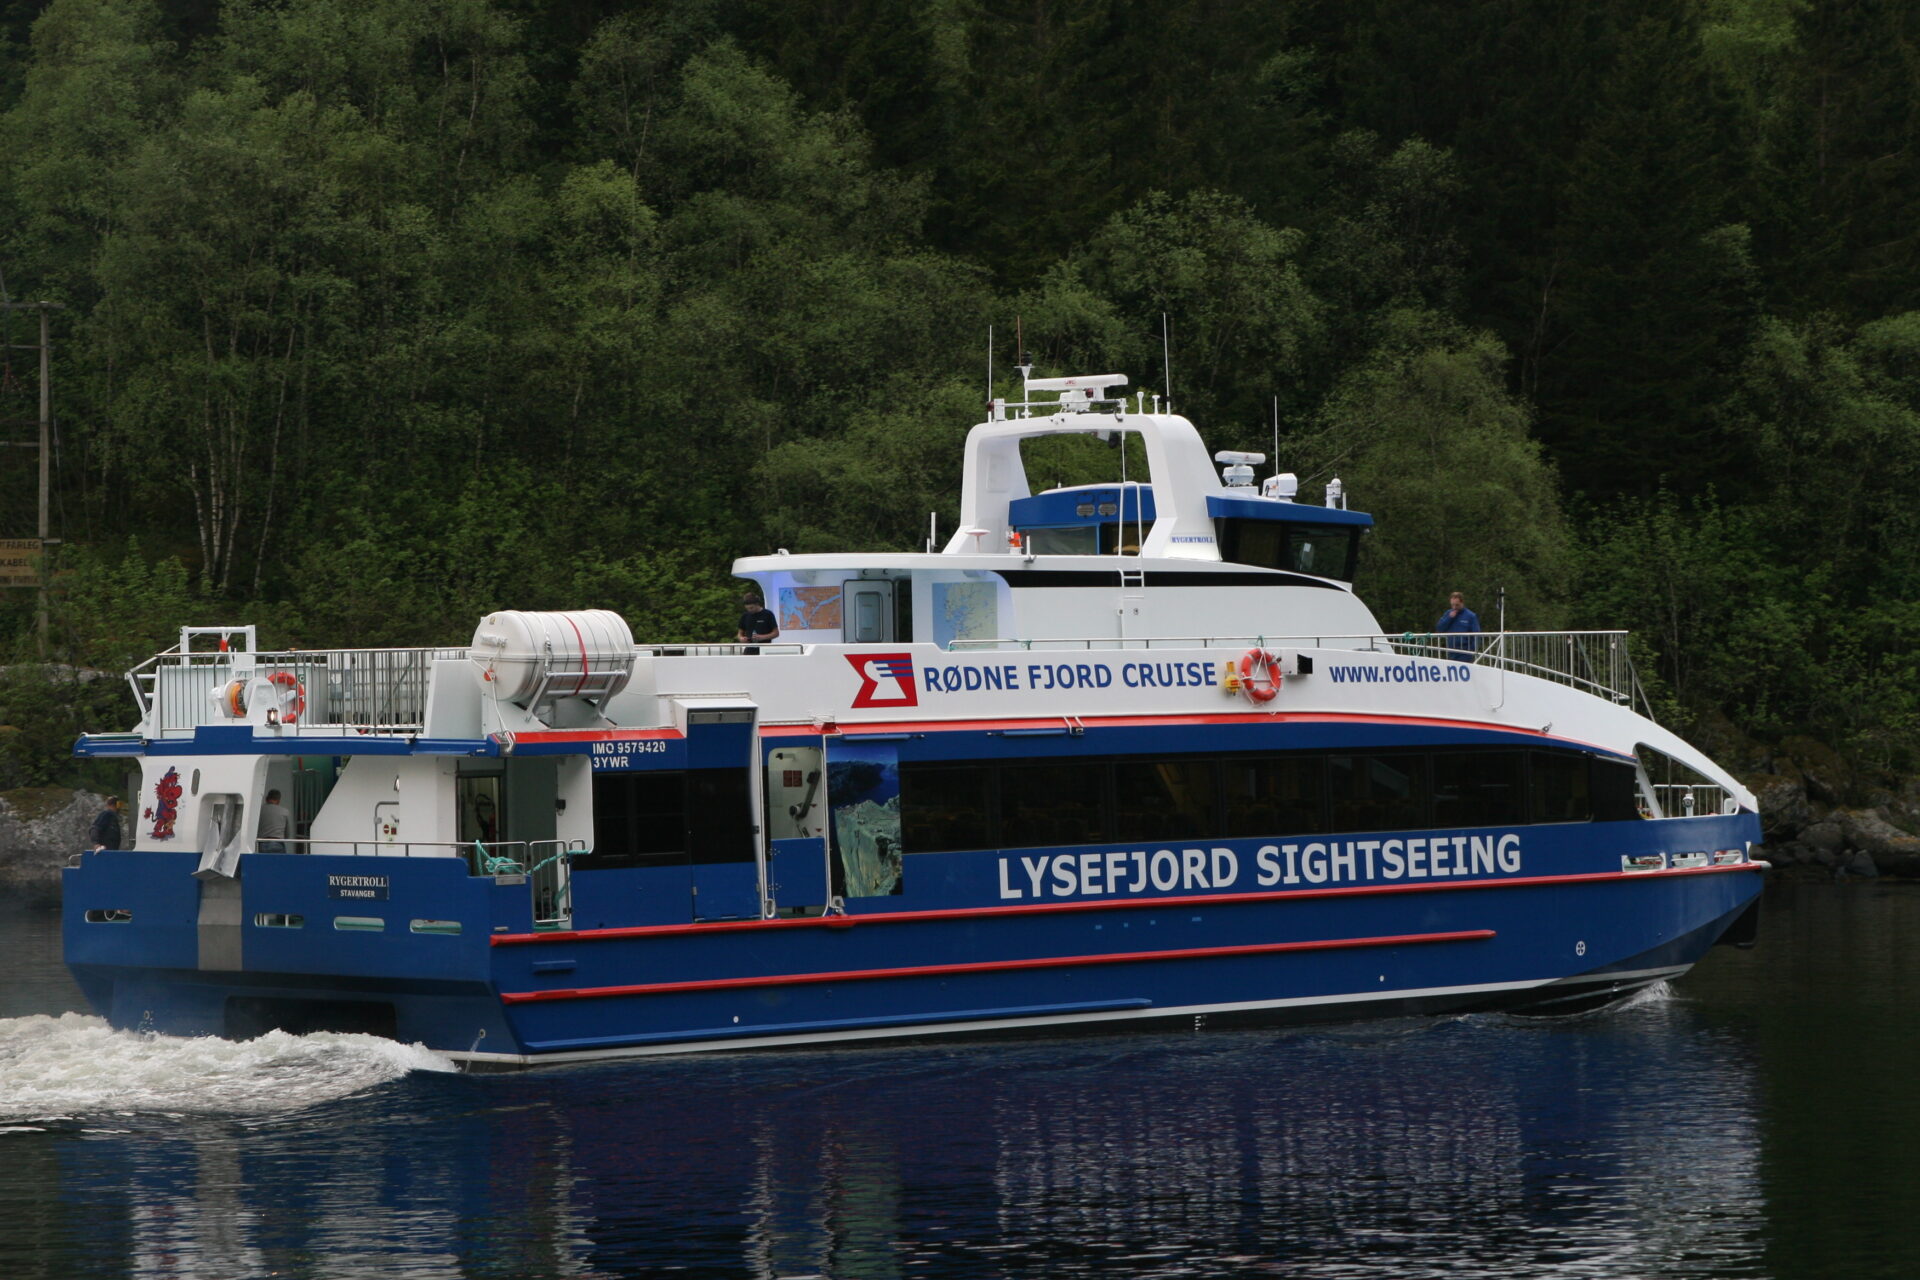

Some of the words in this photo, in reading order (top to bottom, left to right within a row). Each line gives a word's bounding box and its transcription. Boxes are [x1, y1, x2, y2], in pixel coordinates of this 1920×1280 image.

[923, 665, 1019, 693] RØDNE
[1027, 664, 1112, 690] FJORD
[1122, 662, 1217, 688] CRUISE
[1329, 660, 1470, 683] www.rodne.no
[592, 743, 615, 754] IMO
[617, 741, 666, 753] 9579420
[593, 756, 630, 768] 3YWR
[998, 848, 1239, 899] LYSEFJORD
[1256, 834, 1521, 886] SIGHTSEEING
[329, 875, 387, 887] RYGERTROLL
[340, 889, 376, 898] STAVANGER
